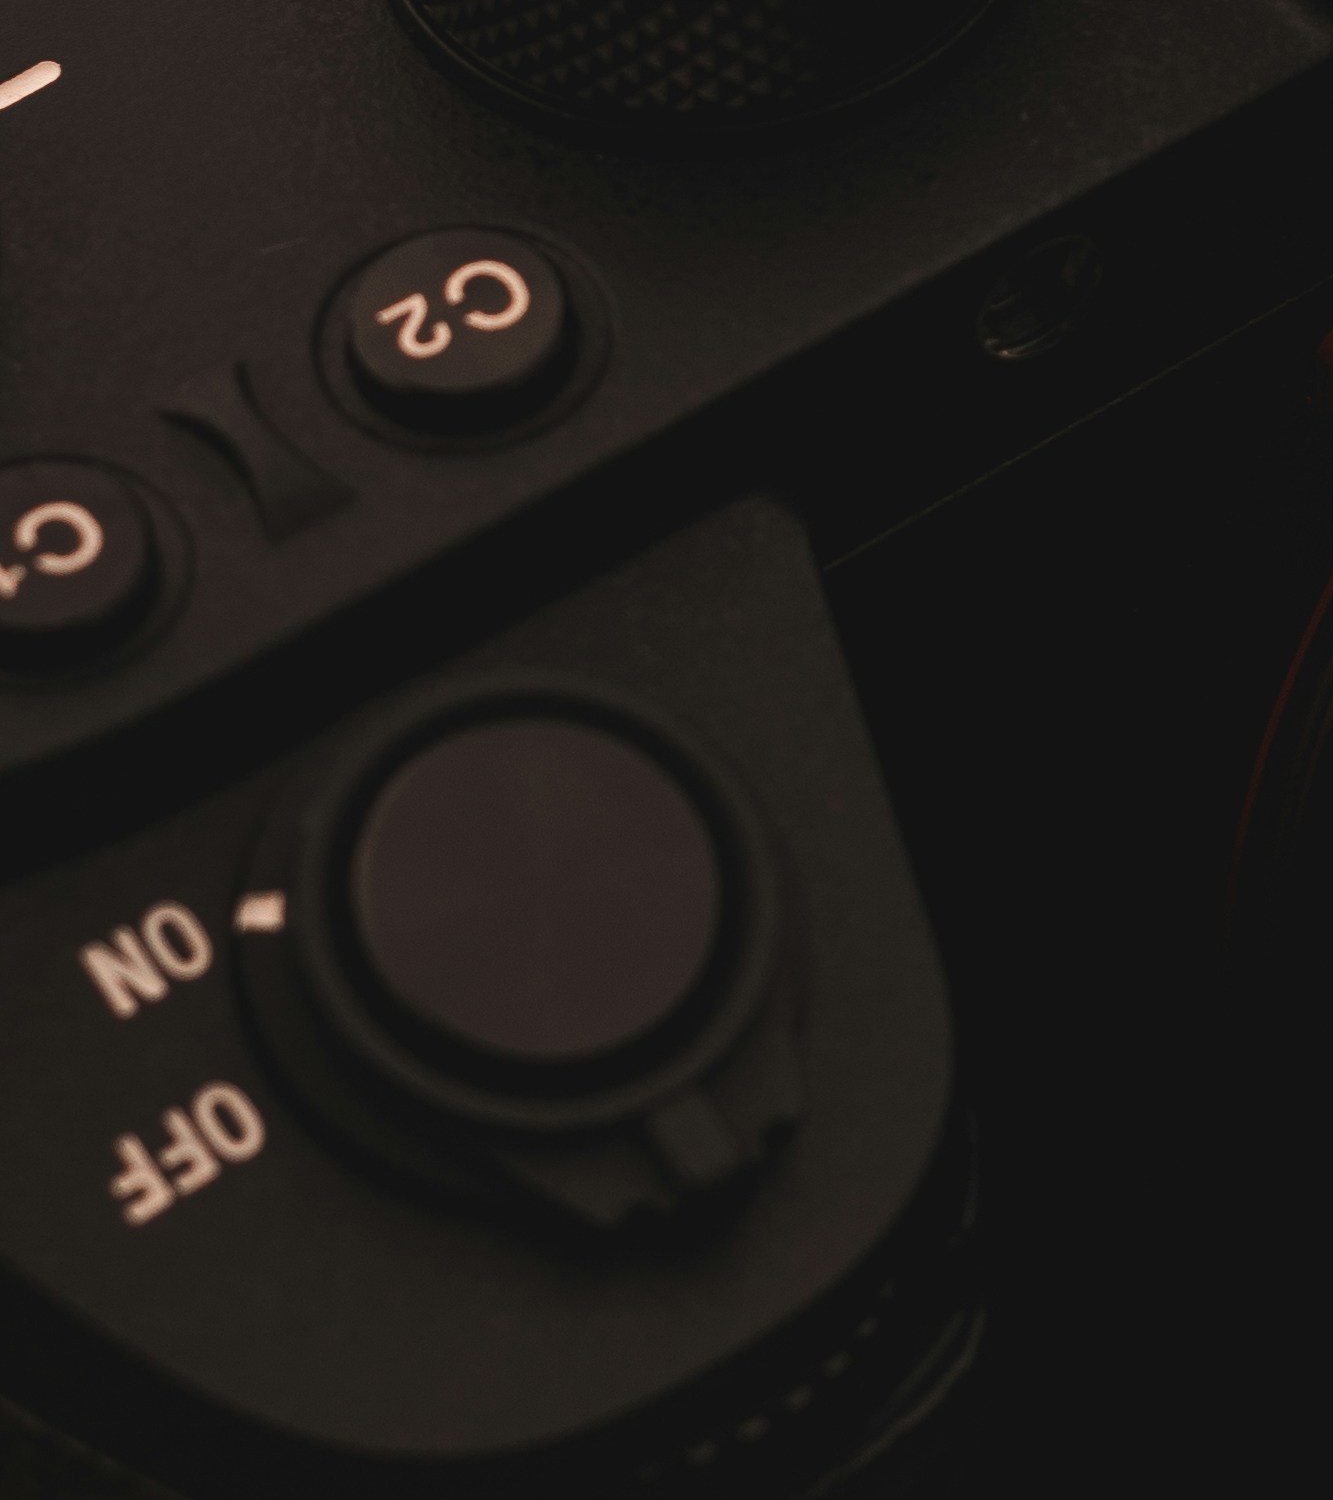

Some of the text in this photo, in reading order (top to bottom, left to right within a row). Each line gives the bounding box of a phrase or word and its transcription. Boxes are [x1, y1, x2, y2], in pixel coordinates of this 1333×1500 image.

[374, 258, 530, 359] C2
[79, 900, 214, 1020] ON
[109, 1080, 267, 1228] OFF
